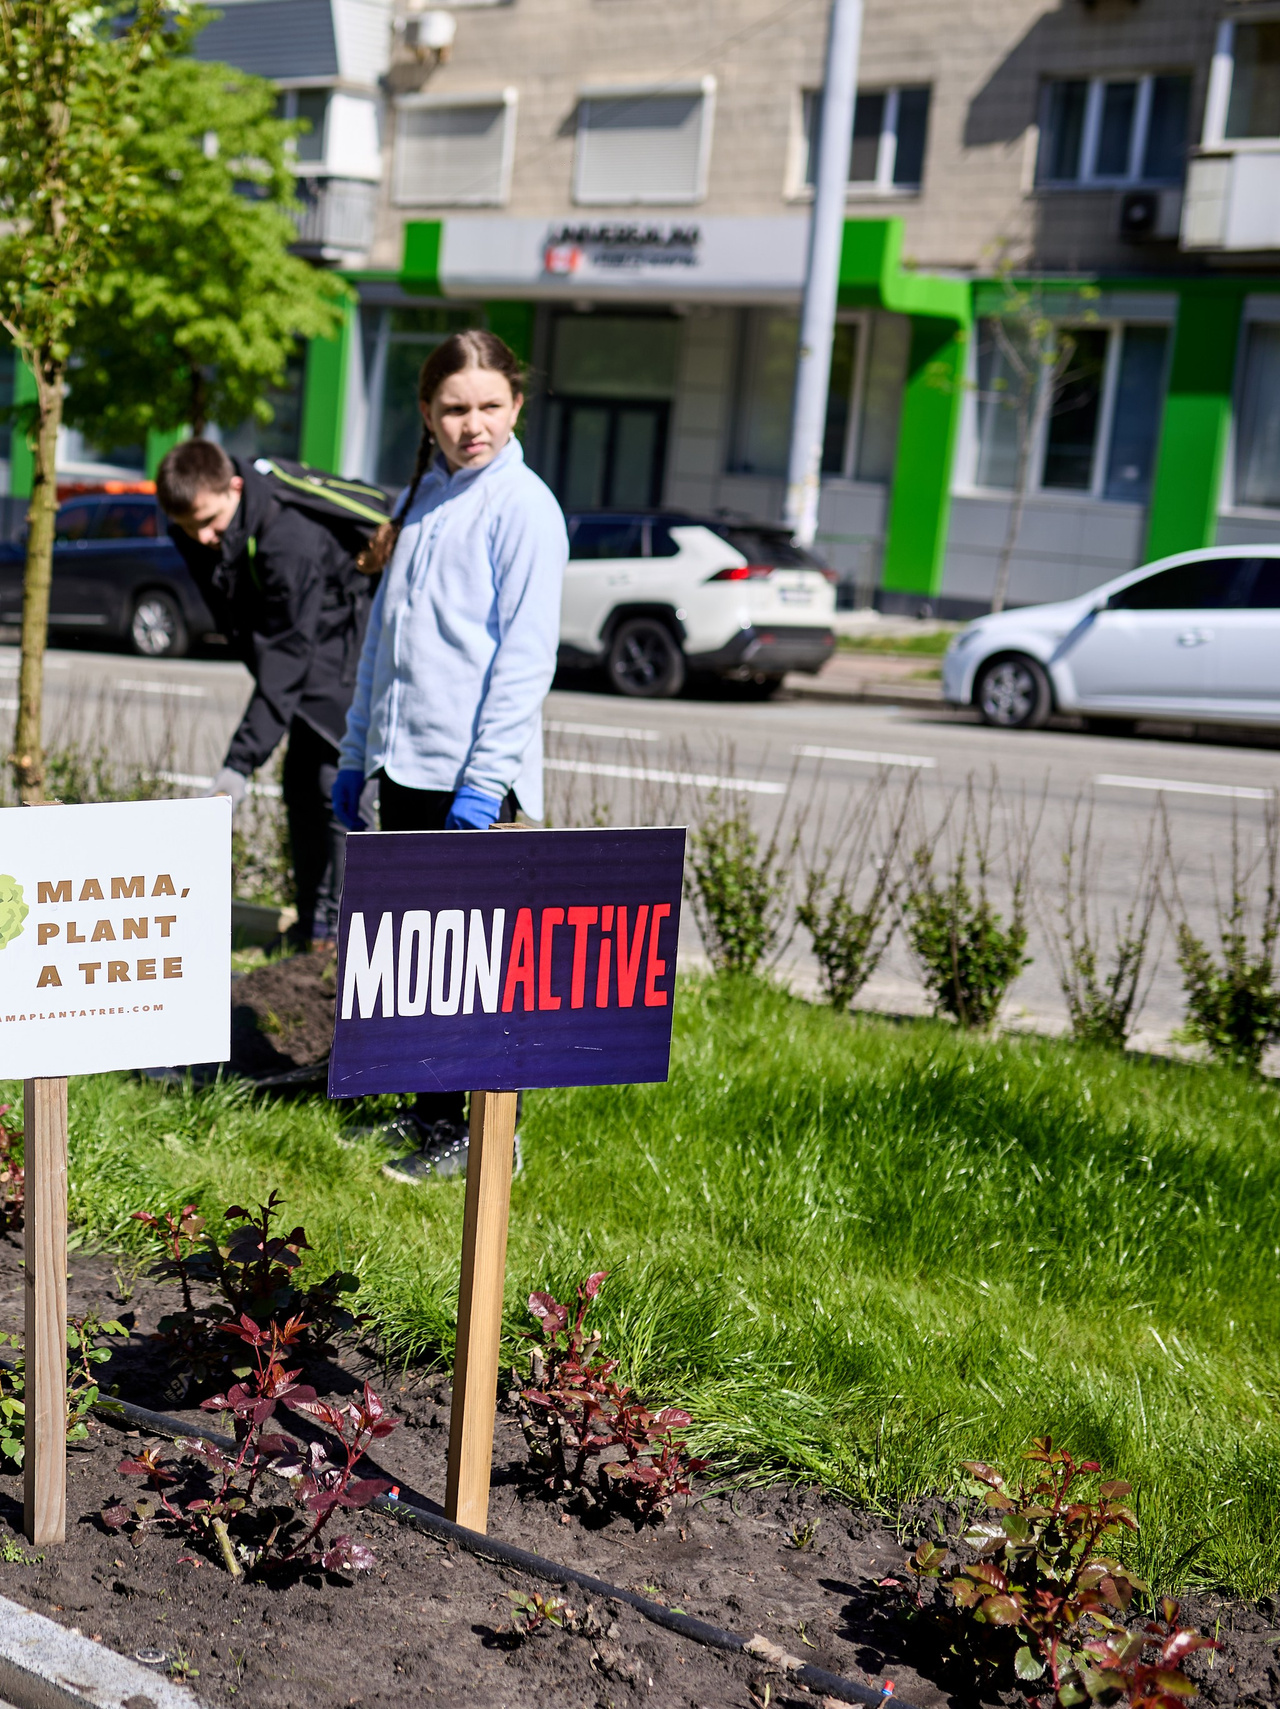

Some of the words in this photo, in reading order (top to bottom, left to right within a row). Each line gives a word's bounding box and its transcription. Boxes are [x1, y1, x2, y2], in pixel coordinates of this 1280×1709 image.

[37, 873, 191, 904] MAMA,
[37, 914, 178, 946] PLANT
[36, 964, 63, 989] A
[78, 956, 184, 985] TREE
